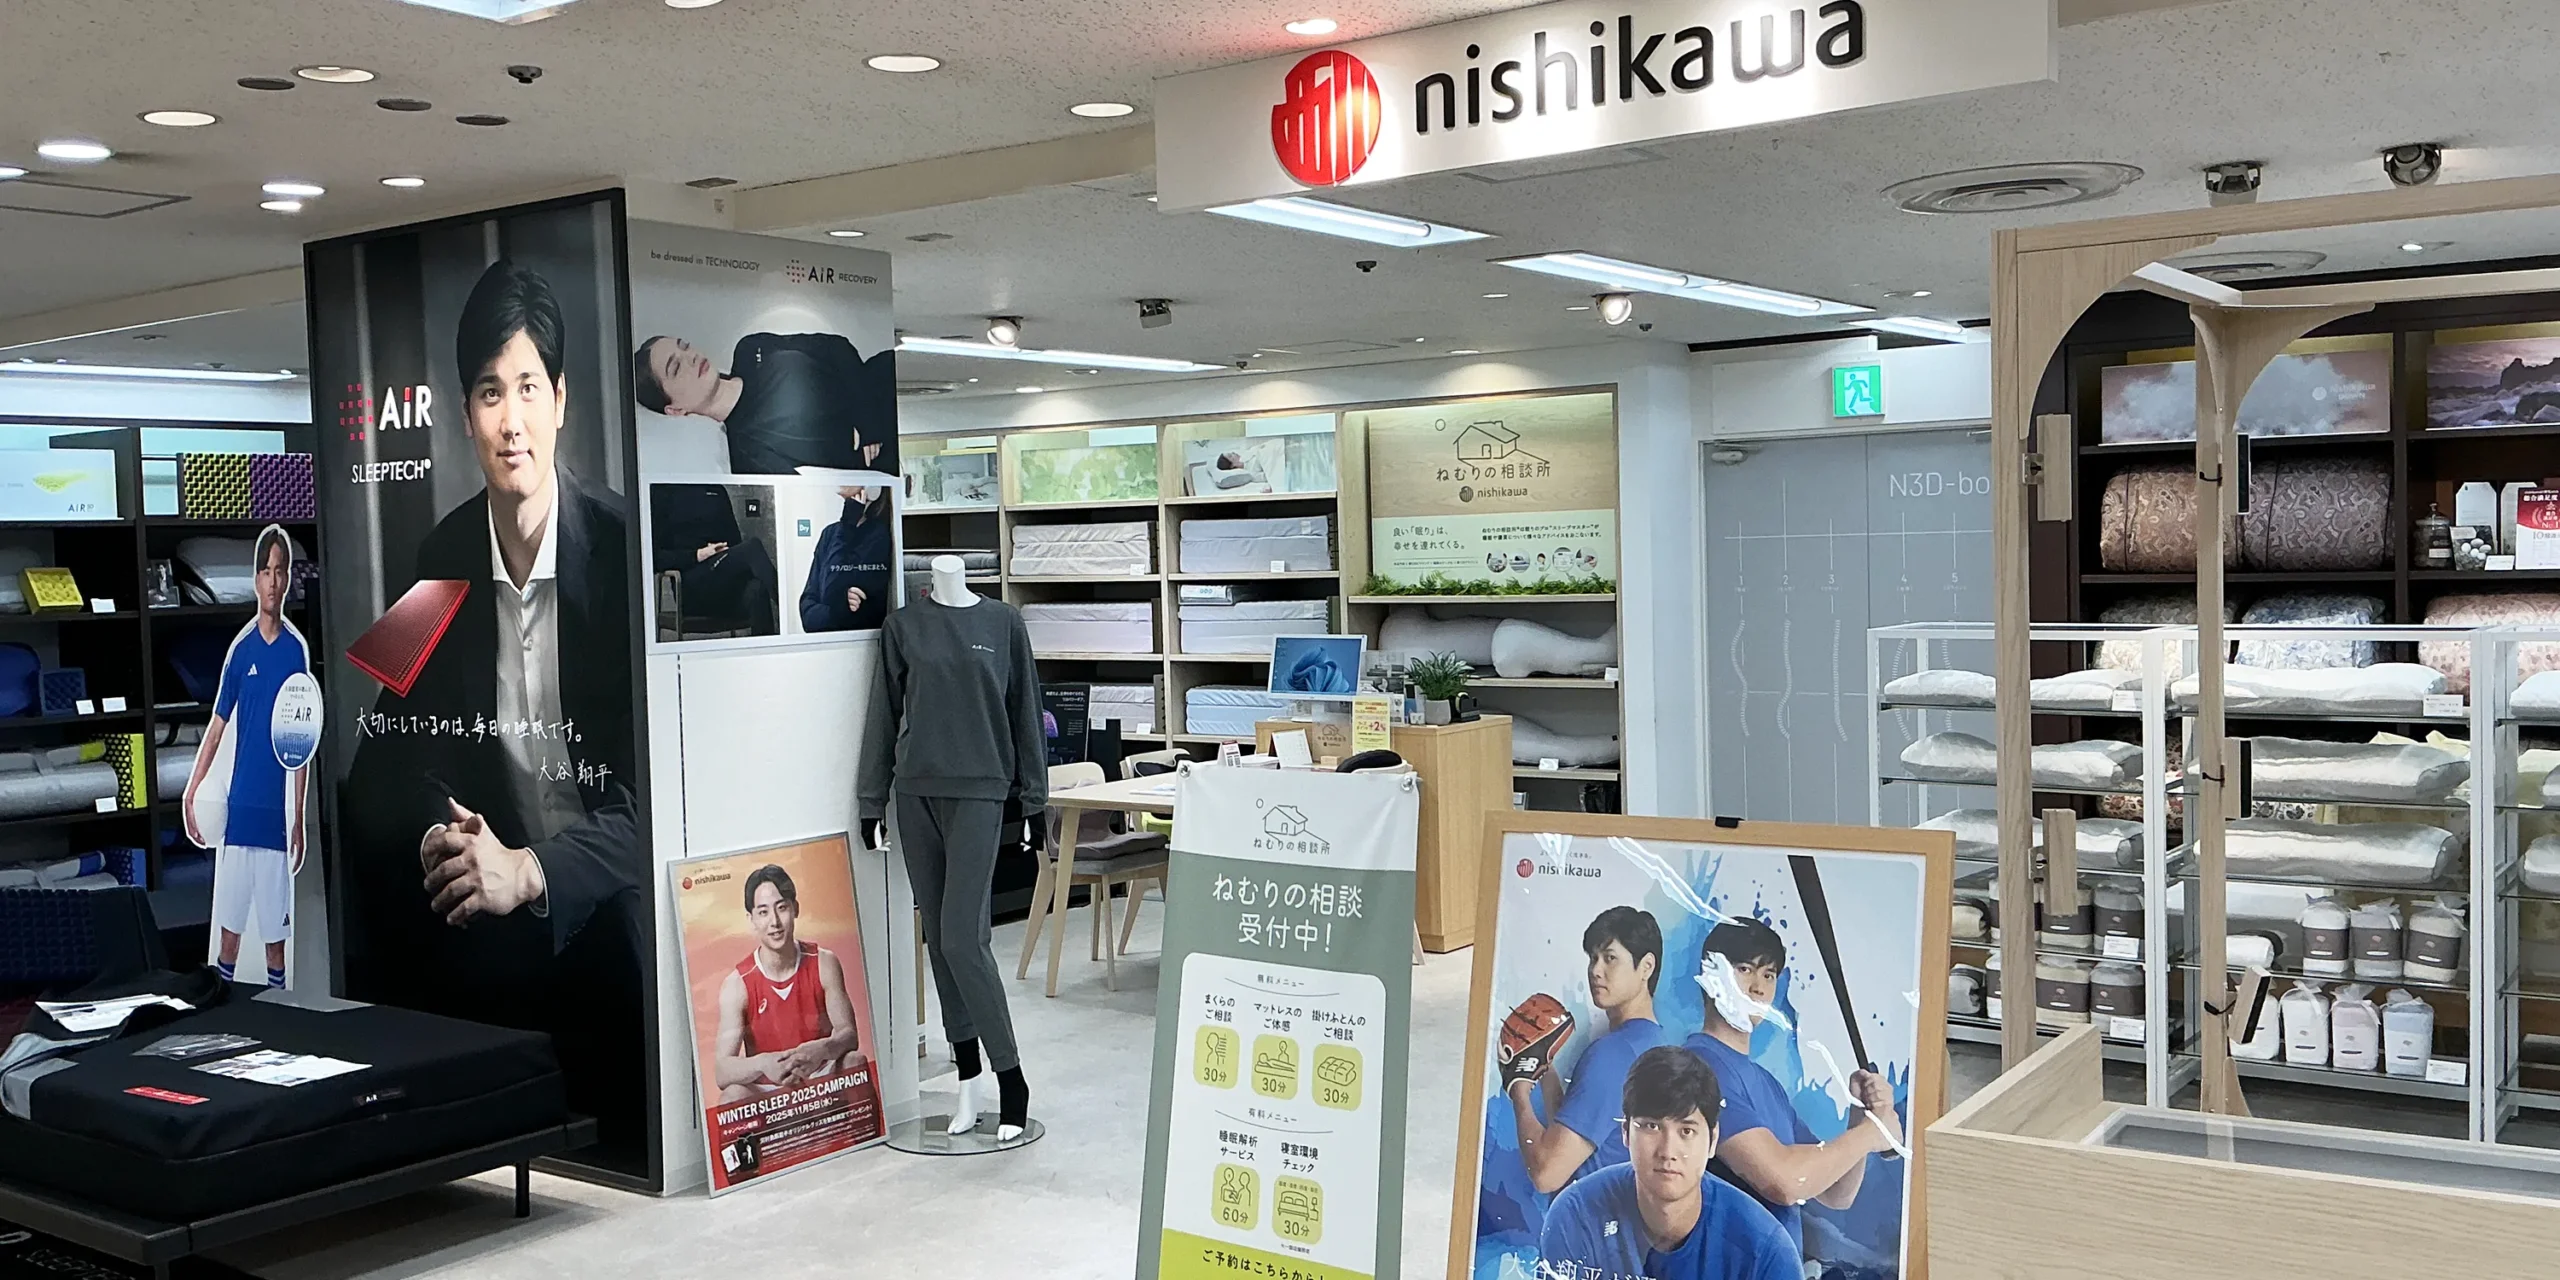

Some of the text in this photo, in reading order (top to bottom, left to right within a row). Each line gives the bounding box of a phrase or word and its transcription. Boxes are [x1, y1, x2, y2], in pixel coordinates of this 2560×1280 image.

[1415, 0, 1868, 135] nishikawa
[650, 249, 661, 259] be
[663, 250, 694, 264] dressed
[705, 256, 760, 272] TECHNOLOGY
[839, 273, 879, 284] RECOVERY
[1436, 462, 1551, 482] ねむりの相談所
[1477, 487, 1528, 498] nishikawa
[799, 523, 809, 534] Dry
[1253, 837, 1330, 855] ねむりの相談所
[695, 873, 731, 885] nishikawa
[1212, 873, 1363, 918] ねむりの相談
[1257, 974, 1305, 988] 無料メニュー
[1204, 994, 1235, 1007] まくらの
[1205, 1009, 1232, 1023] ご相談
[1254, 1002, 1302, 1018] マットレスの
[1312, 1009, 1366, 1026] 掛けふとんの
[1263, 1018, 1291, 1032] ご体感
[1323, 1027, 1354, 1041] ご相談
[1203, 1067, 1227, 1083] 30分
[1262, 1077, 1287, 1093] 30分
[717, 1070, 868, 1126] WINTER SLEEP 2025 CAMPAIGN
[1323, 1088, 1350, 1104] 30分
[1248, 1108, 1297, 1122] 有料メニュー
[1219, 1130, 1258, 1147] 睡眠解析
[1220, 1147, 1255, 1161] サービス
[1281, 1142, 1319, 1159] 寝室環境
[1283, 1159, 1314, 1173] チェック
[1222, 1207, 1249, 1224] 60分
[1284, 1220, 1310, 1237] 30分
